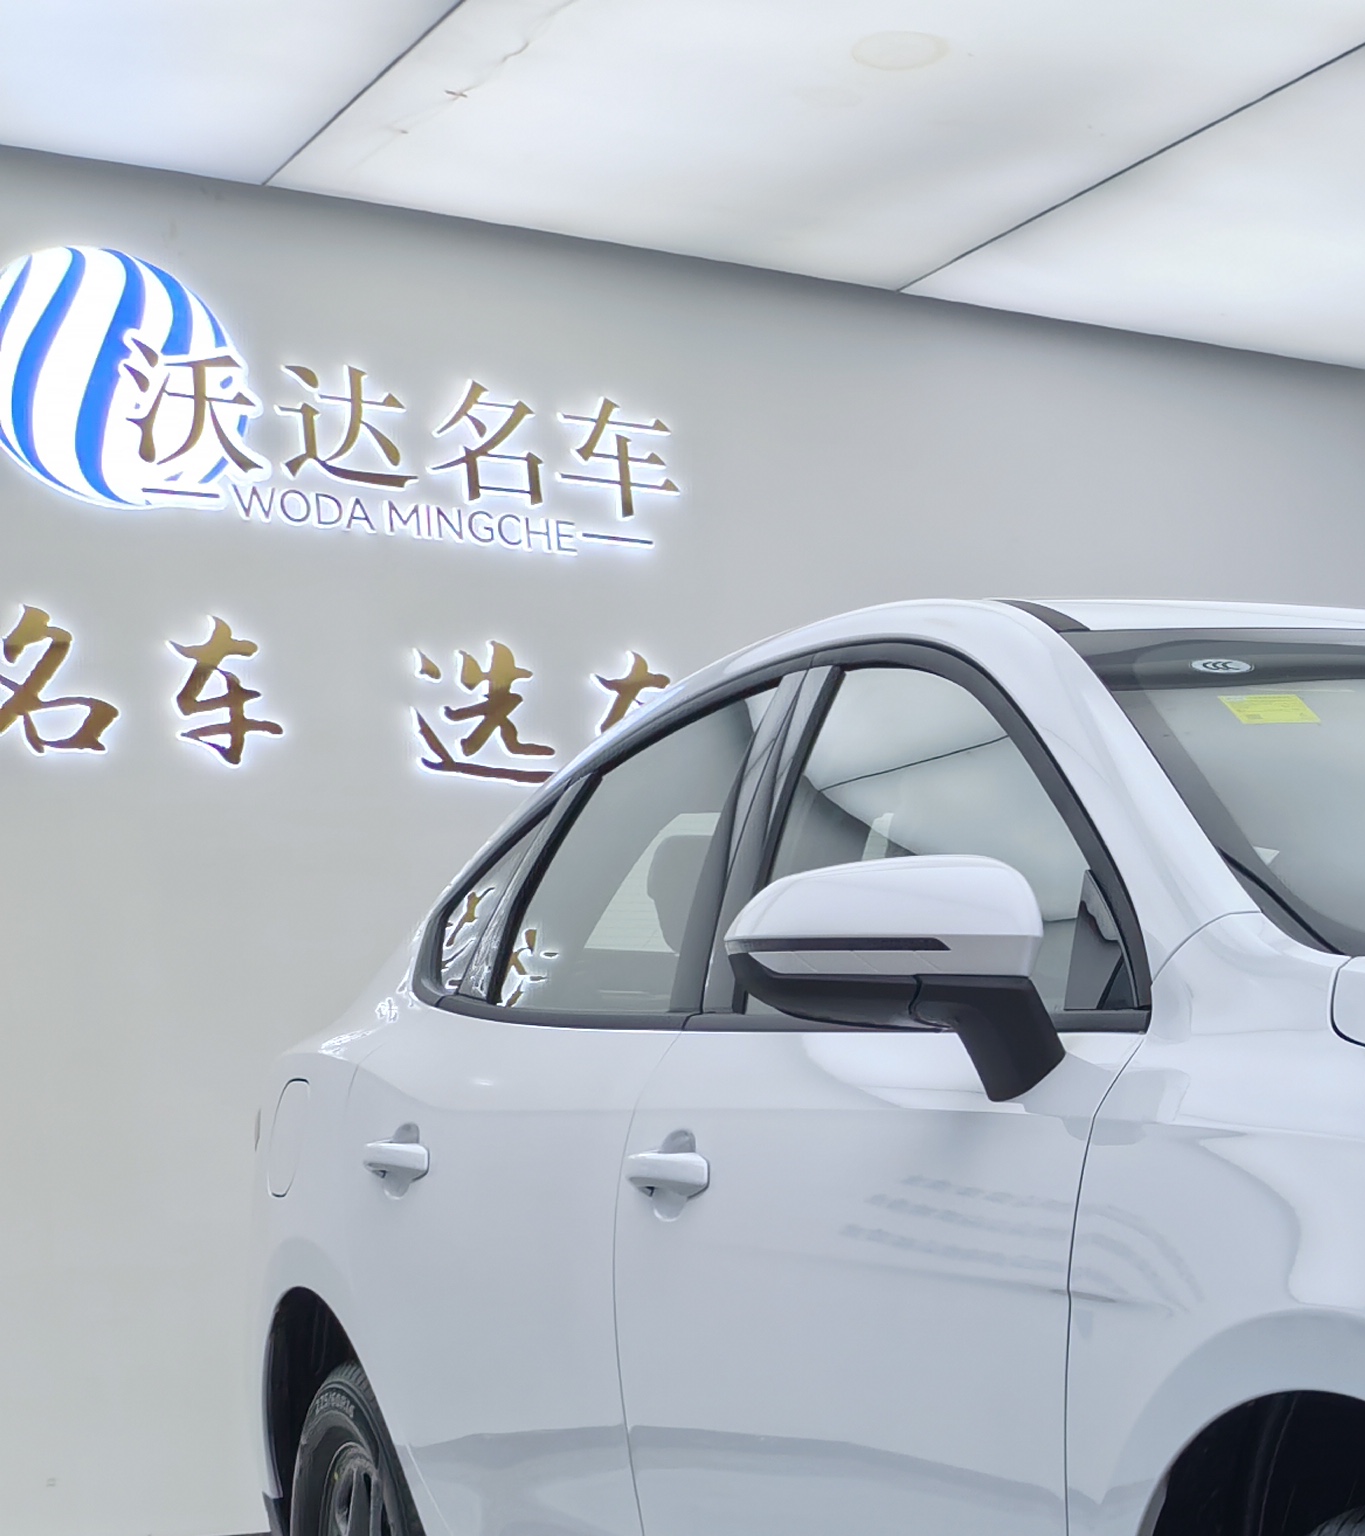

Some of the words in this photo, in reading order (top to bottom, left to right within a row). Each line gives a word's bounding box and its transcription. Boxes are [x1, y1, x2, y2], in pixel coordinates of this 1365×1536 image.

[122, 335, 681, 519] 沃达名车
[231, 483, 376, 534] WODA
[387, 498, 580, 555] MINGCHE
